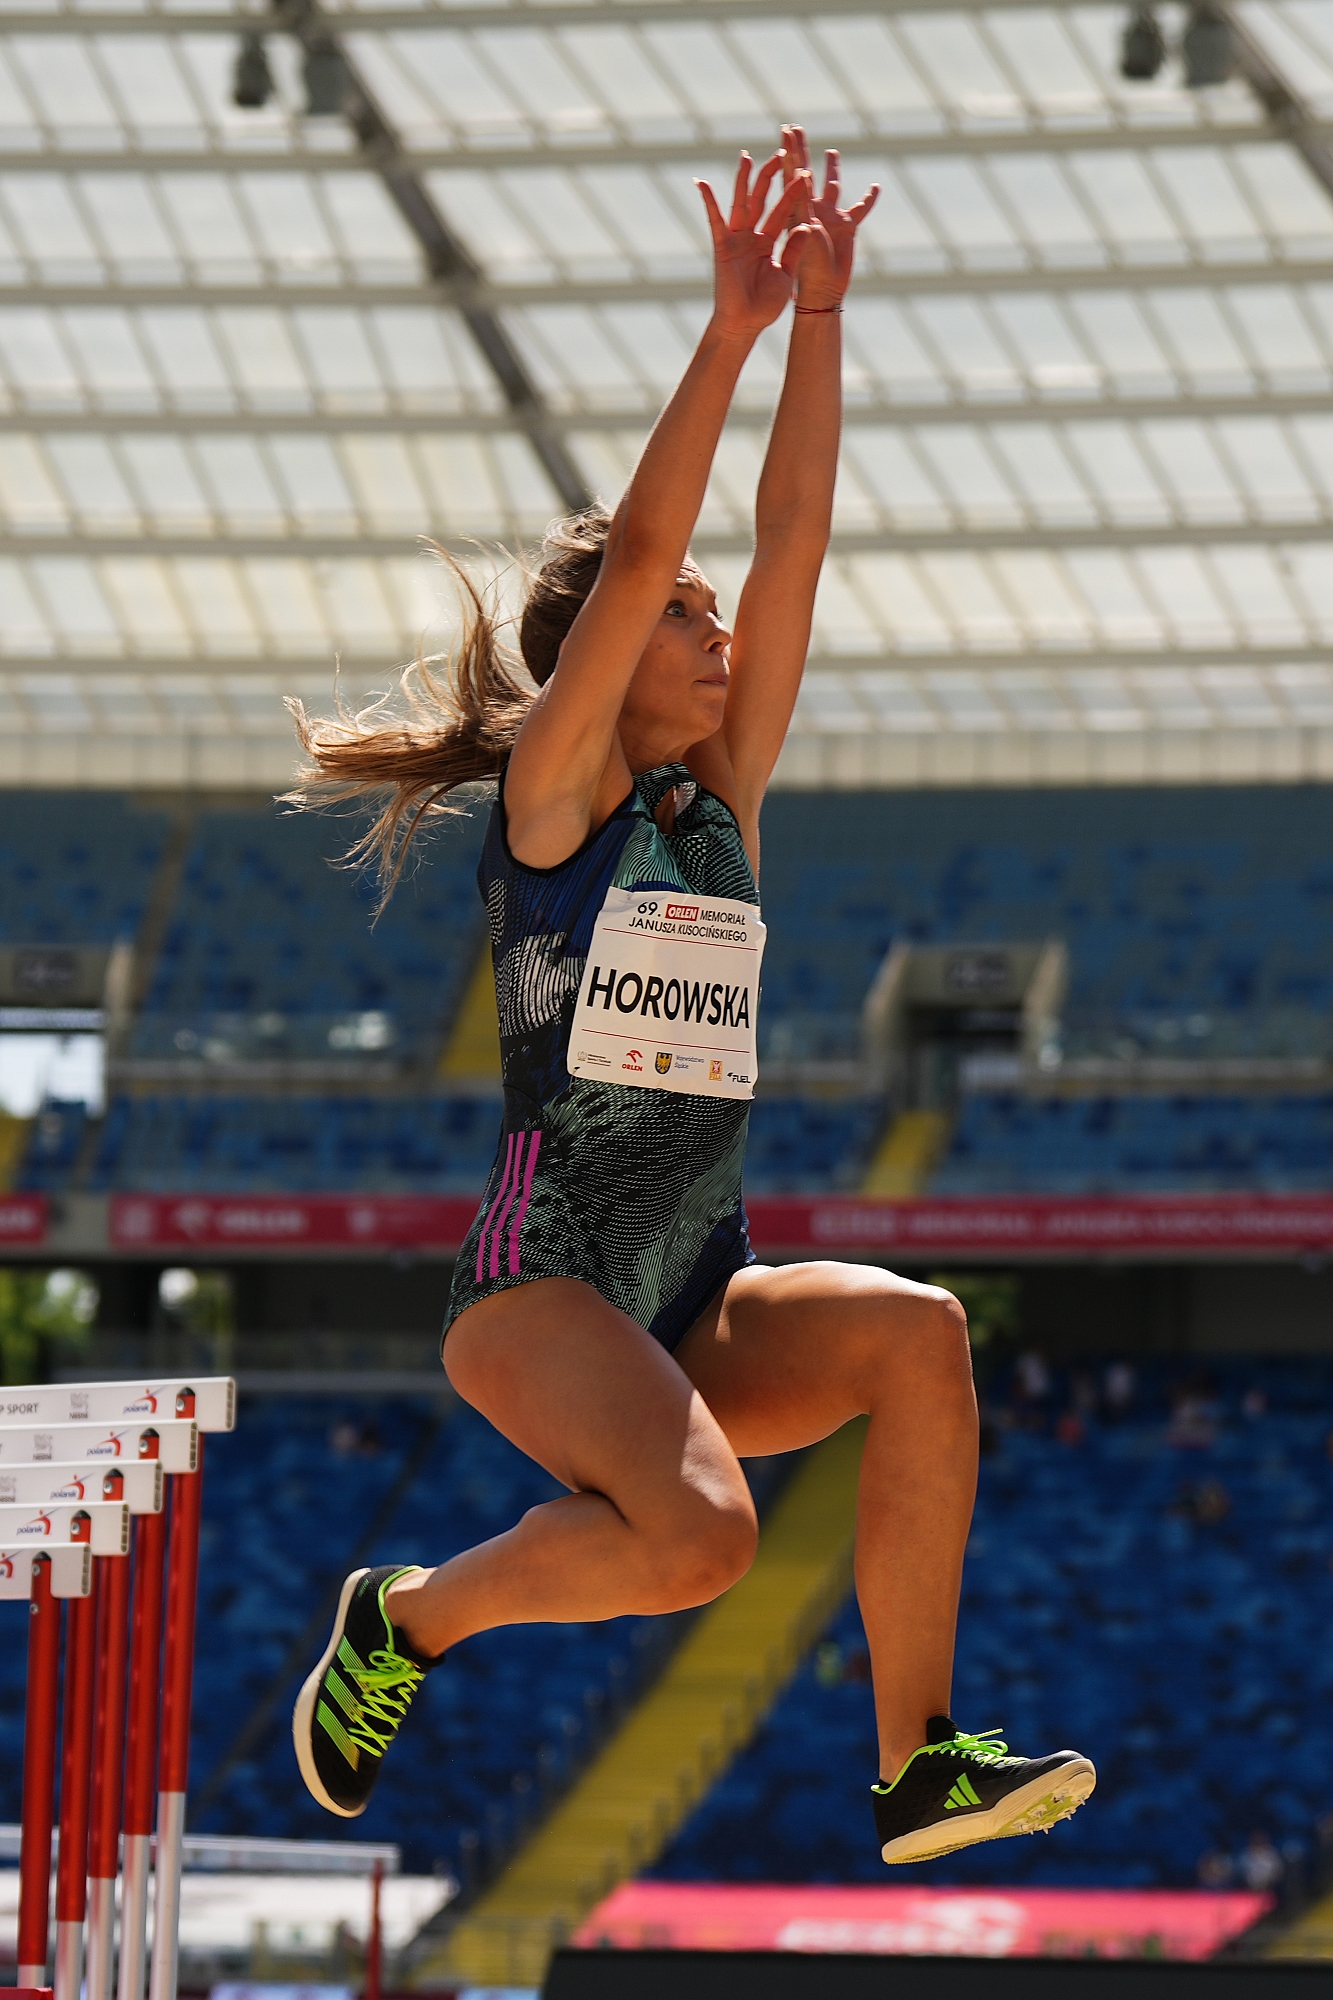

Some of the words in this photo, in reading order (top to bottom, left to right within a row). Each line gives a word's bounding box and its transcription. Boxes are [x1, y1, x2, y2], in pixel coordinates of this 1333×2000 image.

[637, 901, 662, 918] 69.
[667, 905, 697, 920] ORLEN
[699, 909, 747, 926] MEMORIAŁ
[628, 916, 677, 934] JANUSZA
[676, 924, 748, 943] KUSOCIŃSKIEGO
[586, 966, 751, 1029] HOROWSKA
[621, 1063, 644, 1072] ORLEN
[7, 1402, 40, 1415] SPORT
[50, 1490, 77, 1501] polanik
[16, 1525, 44, 1536] polanik
